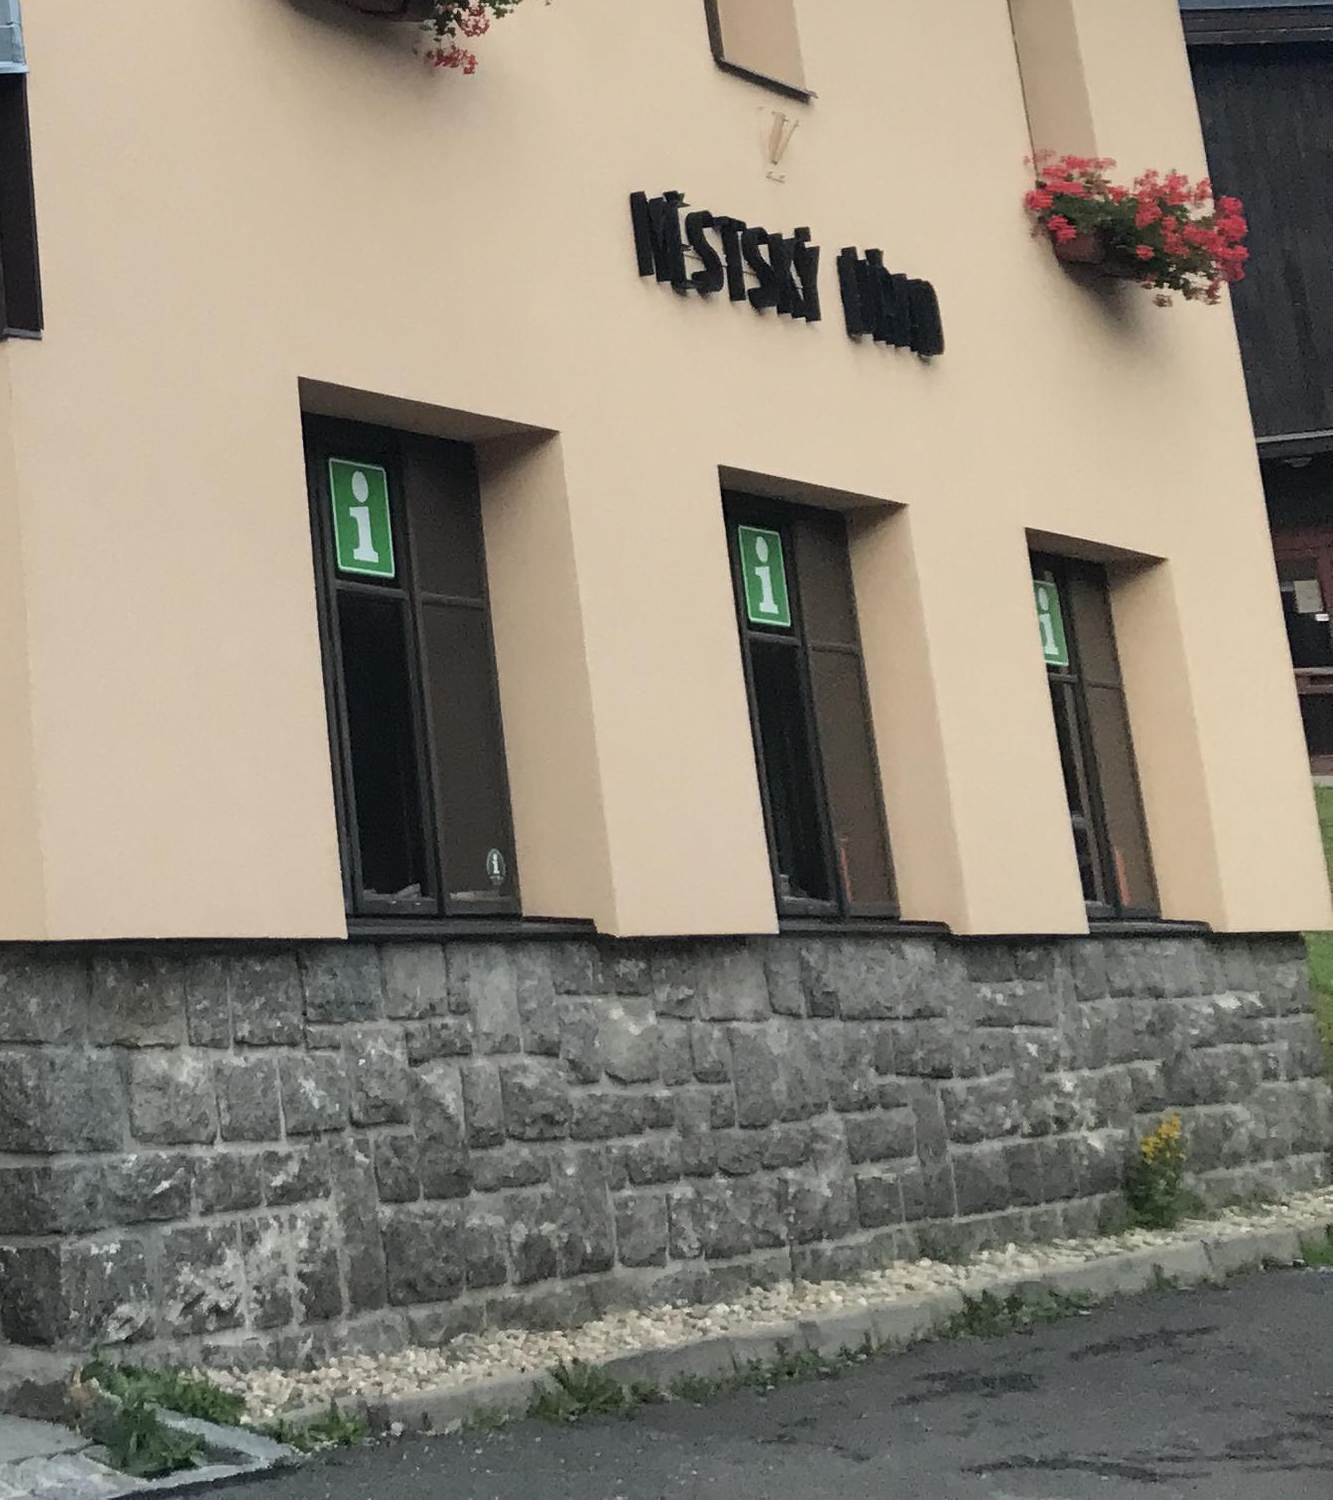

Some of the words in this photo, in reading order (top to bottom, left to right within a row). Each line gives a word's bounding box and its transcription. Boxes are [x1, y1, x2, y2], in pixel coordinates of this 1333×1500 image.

[349, 470, 379, 563] i
[755, 536, 779, 614] i
[1038, 587, 1059, 655] i
